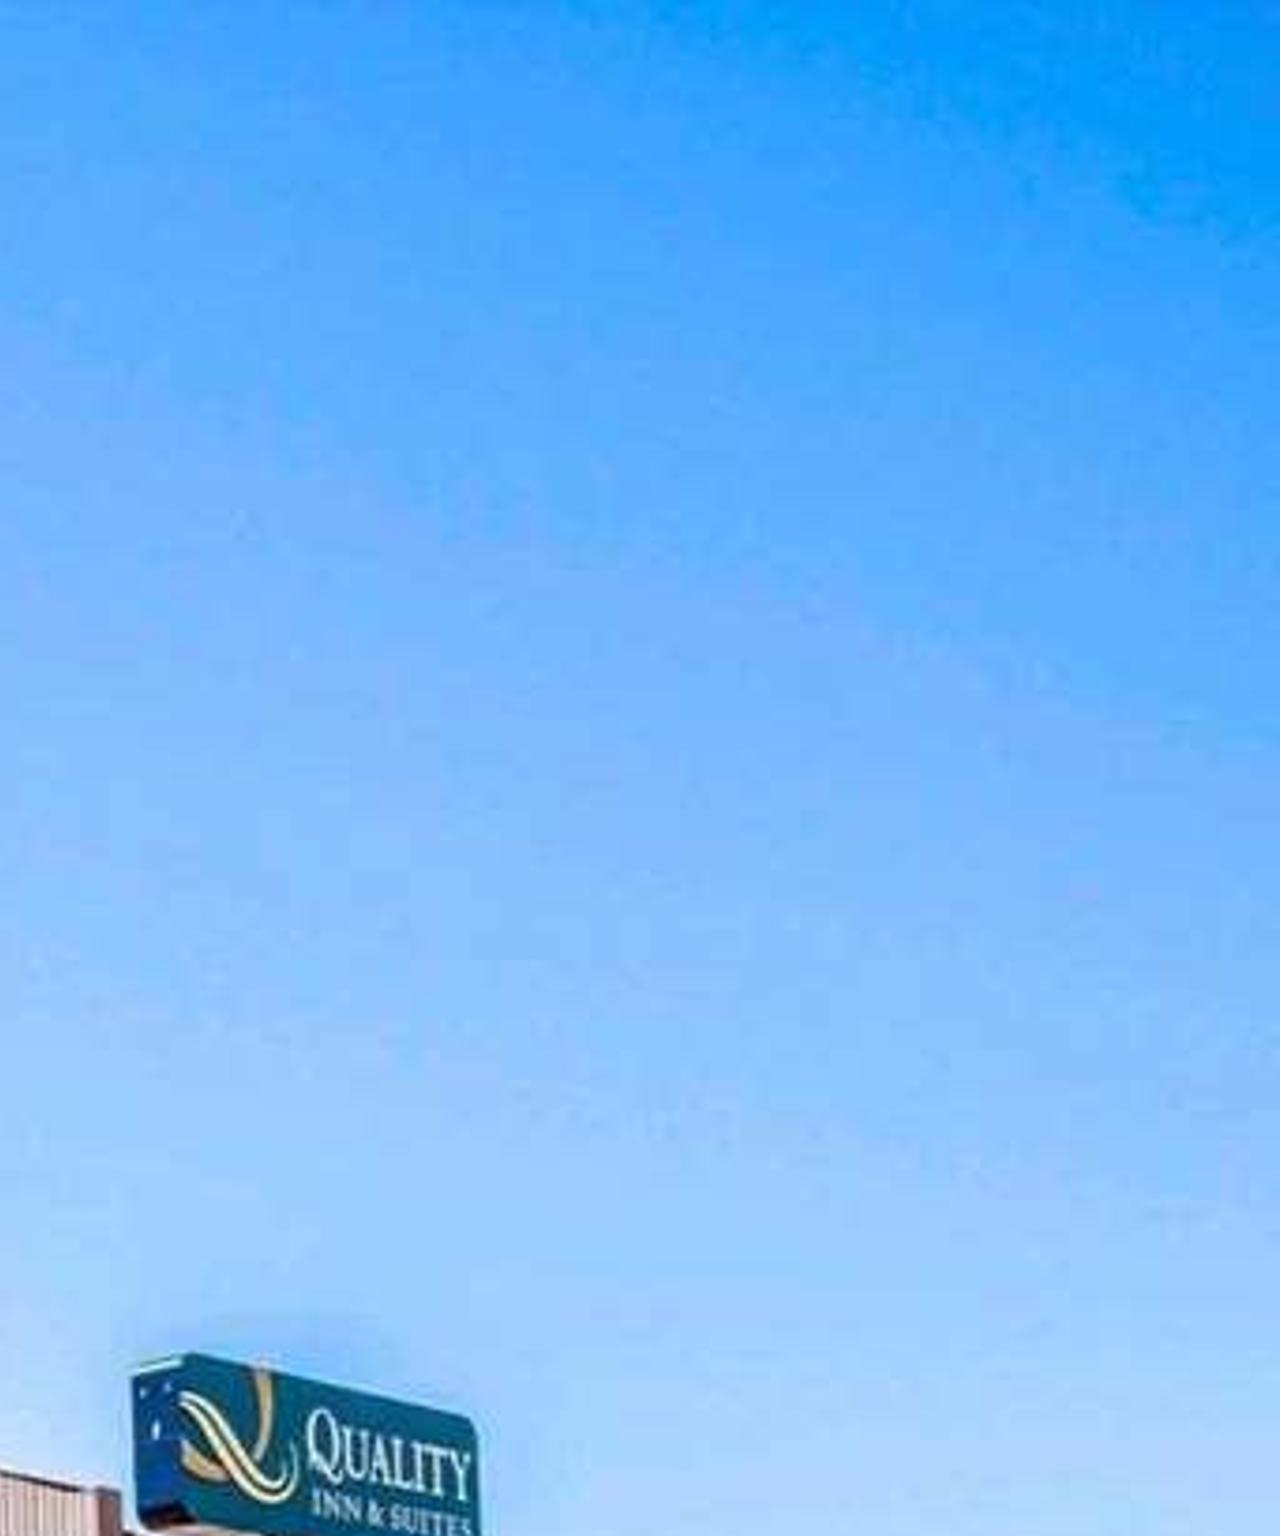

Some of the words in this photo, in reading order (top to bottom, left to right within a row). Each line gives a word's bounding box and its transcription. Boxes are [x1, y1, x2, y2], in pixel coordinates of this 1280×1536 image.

[306, 1408, 471, 1500] QUALITY
[311, 1487, 364, 1523] INN
[367, 1503, 386, 1525] &
